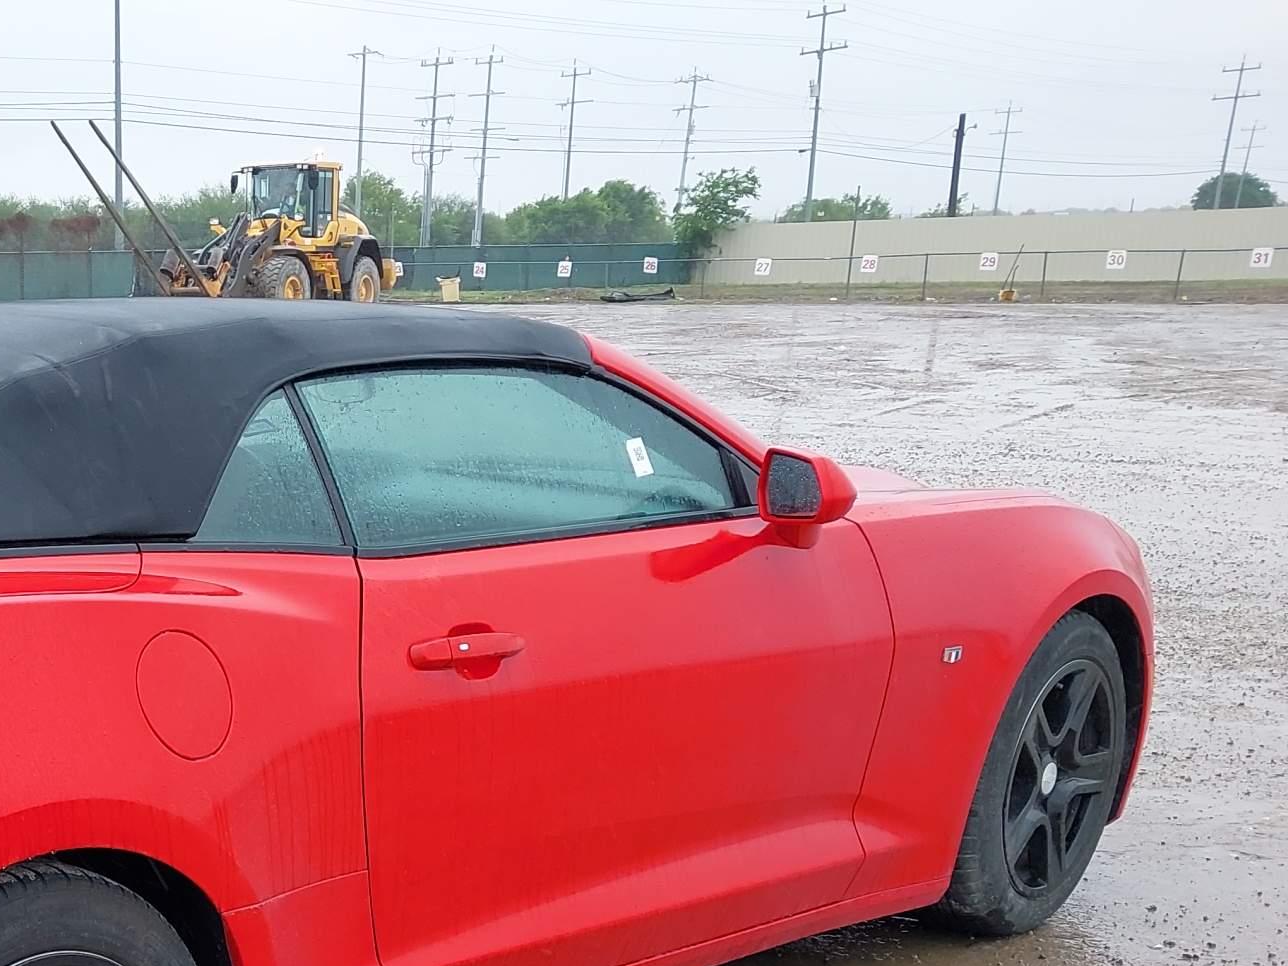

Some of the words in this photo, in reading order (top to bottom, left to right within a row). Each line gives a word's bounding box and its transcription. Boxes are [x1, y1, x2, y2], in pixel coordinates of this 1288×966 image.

[982, 256, 996, 267] 29
[1108, 254, 1124, 266] 30
[1252, 252, 1270, 264] 31
[474, 265, 485, 275] 24
[559, 265, 570, 274] 25
[645, 261, 656, 270] 26
[757, 262, 770, 273] 27
[862, 259, 876, 270] 28
